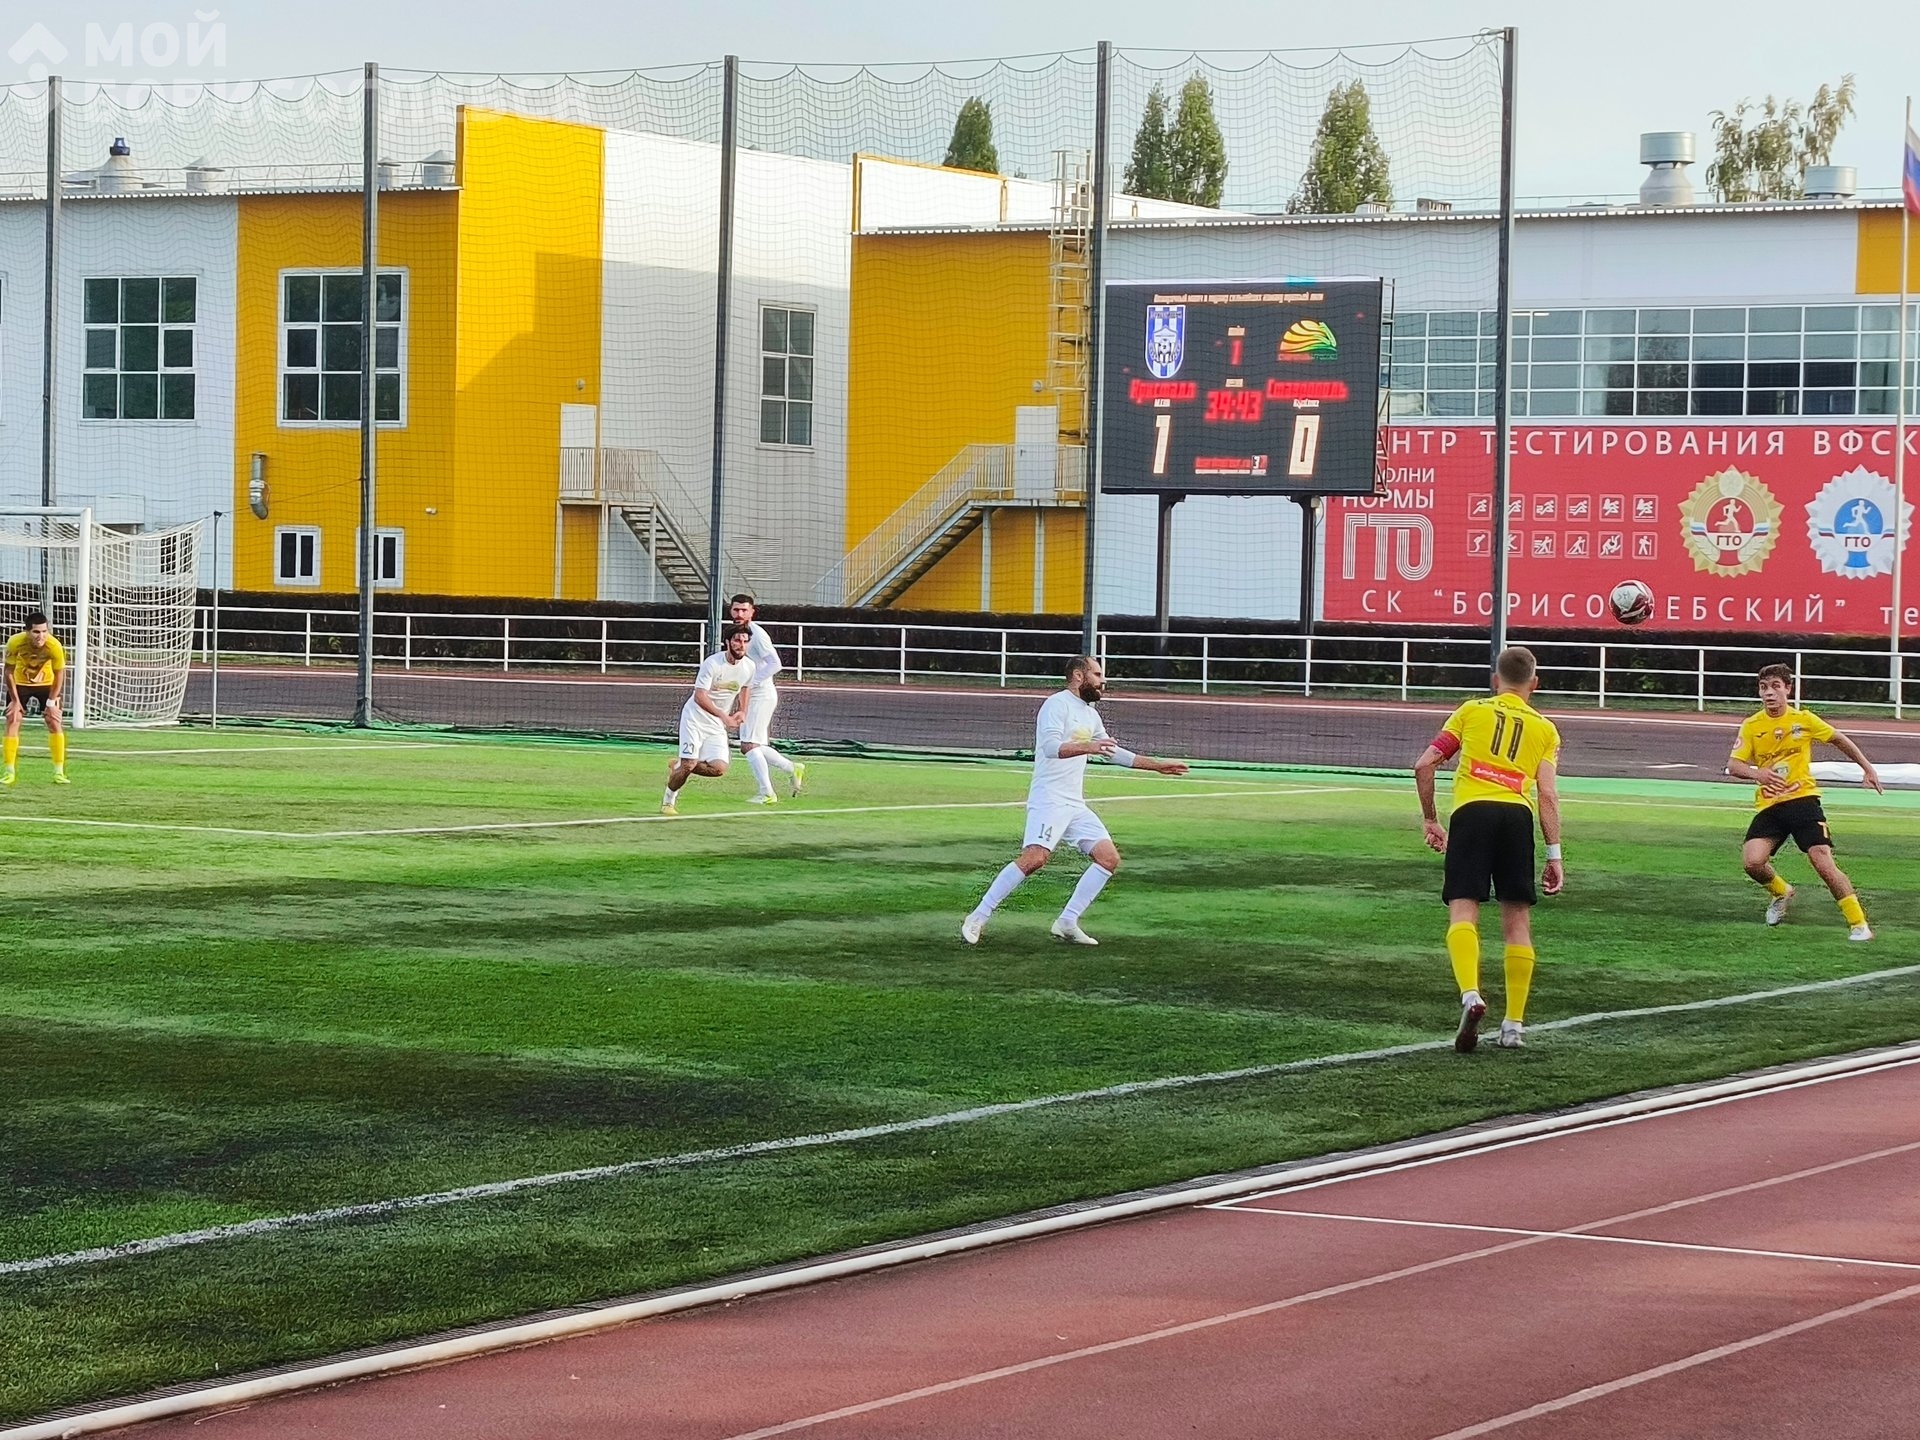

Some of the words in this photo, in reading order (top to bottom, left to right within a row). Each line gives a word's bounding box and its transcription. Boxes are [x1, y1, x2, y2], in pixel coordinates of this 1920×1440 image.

[1153, 414, 1171, 474] 1
[1288, 415, 1321, 475] 0
[1377, 431, 1457, 454] ЕНТР
[1480, 430, 1784, 455] ТЕСТИРОВАНИЯ
[1813, 429, 1919, 455] ВФСК
[1716, 535, 1742, 547] ГТО
[1844, 536, 1871, 548] ГТО
[1362, 589, 1402, 613] СК
[1490, 709, 1524, 763] 11
[1038, 823, 1053, 841] 14
